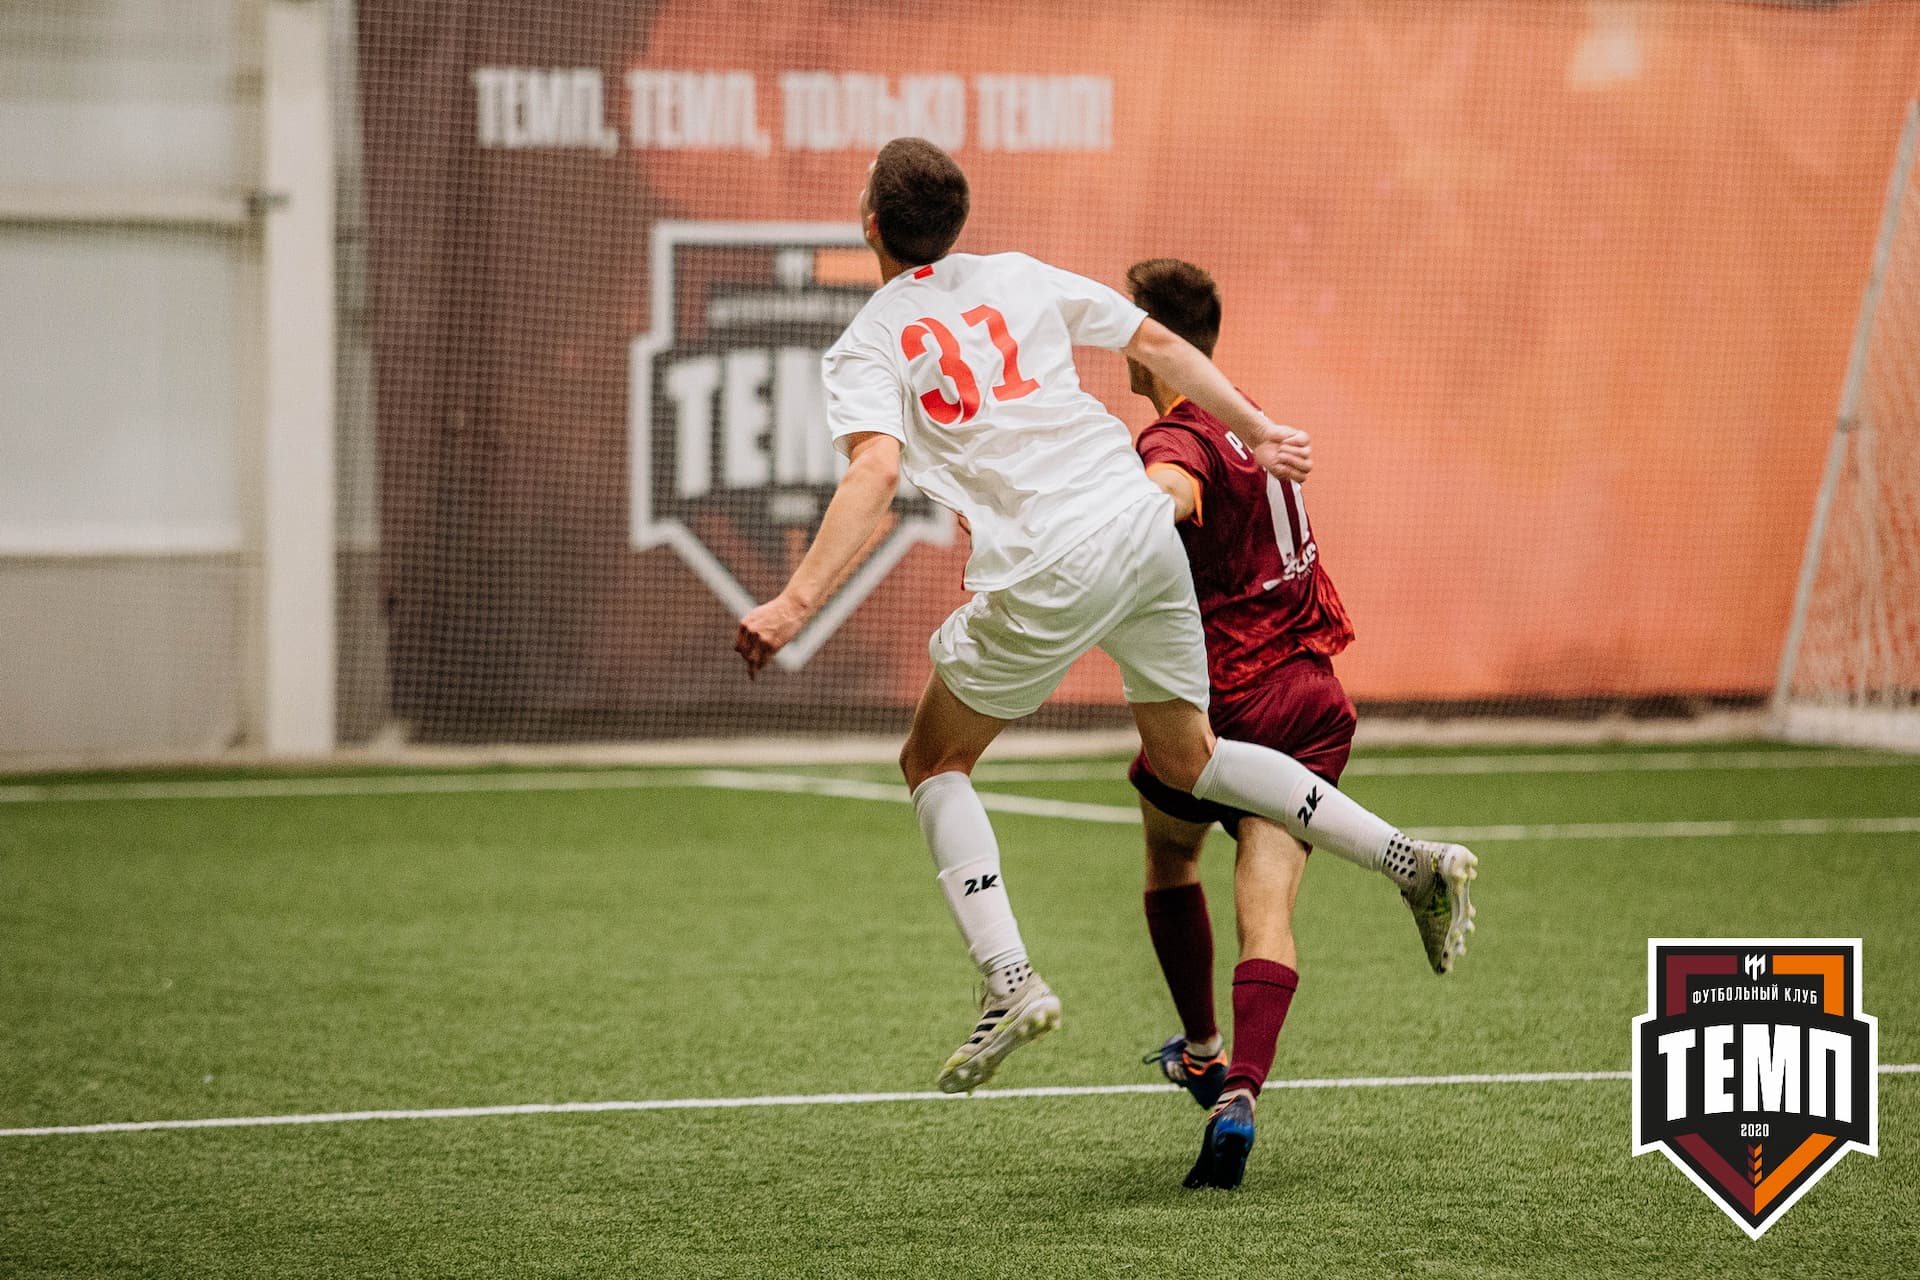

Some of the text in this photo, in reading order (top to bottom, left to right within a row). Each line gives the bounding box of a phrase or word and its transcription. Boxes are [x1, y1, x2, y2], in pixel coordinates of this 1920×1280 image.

[472, 68, 618, 156] ТЕМП,
[627, 71, 769, 156] ТЕМП,
[782, 71, 965, 151] ТОЛЬКО
[901, 304, 1040, 424] 31
[664, 346, 885, 500] ТЕМ
[1297, 785, 1324, 827] 2K
[963, 873, 999, 896] 2K
